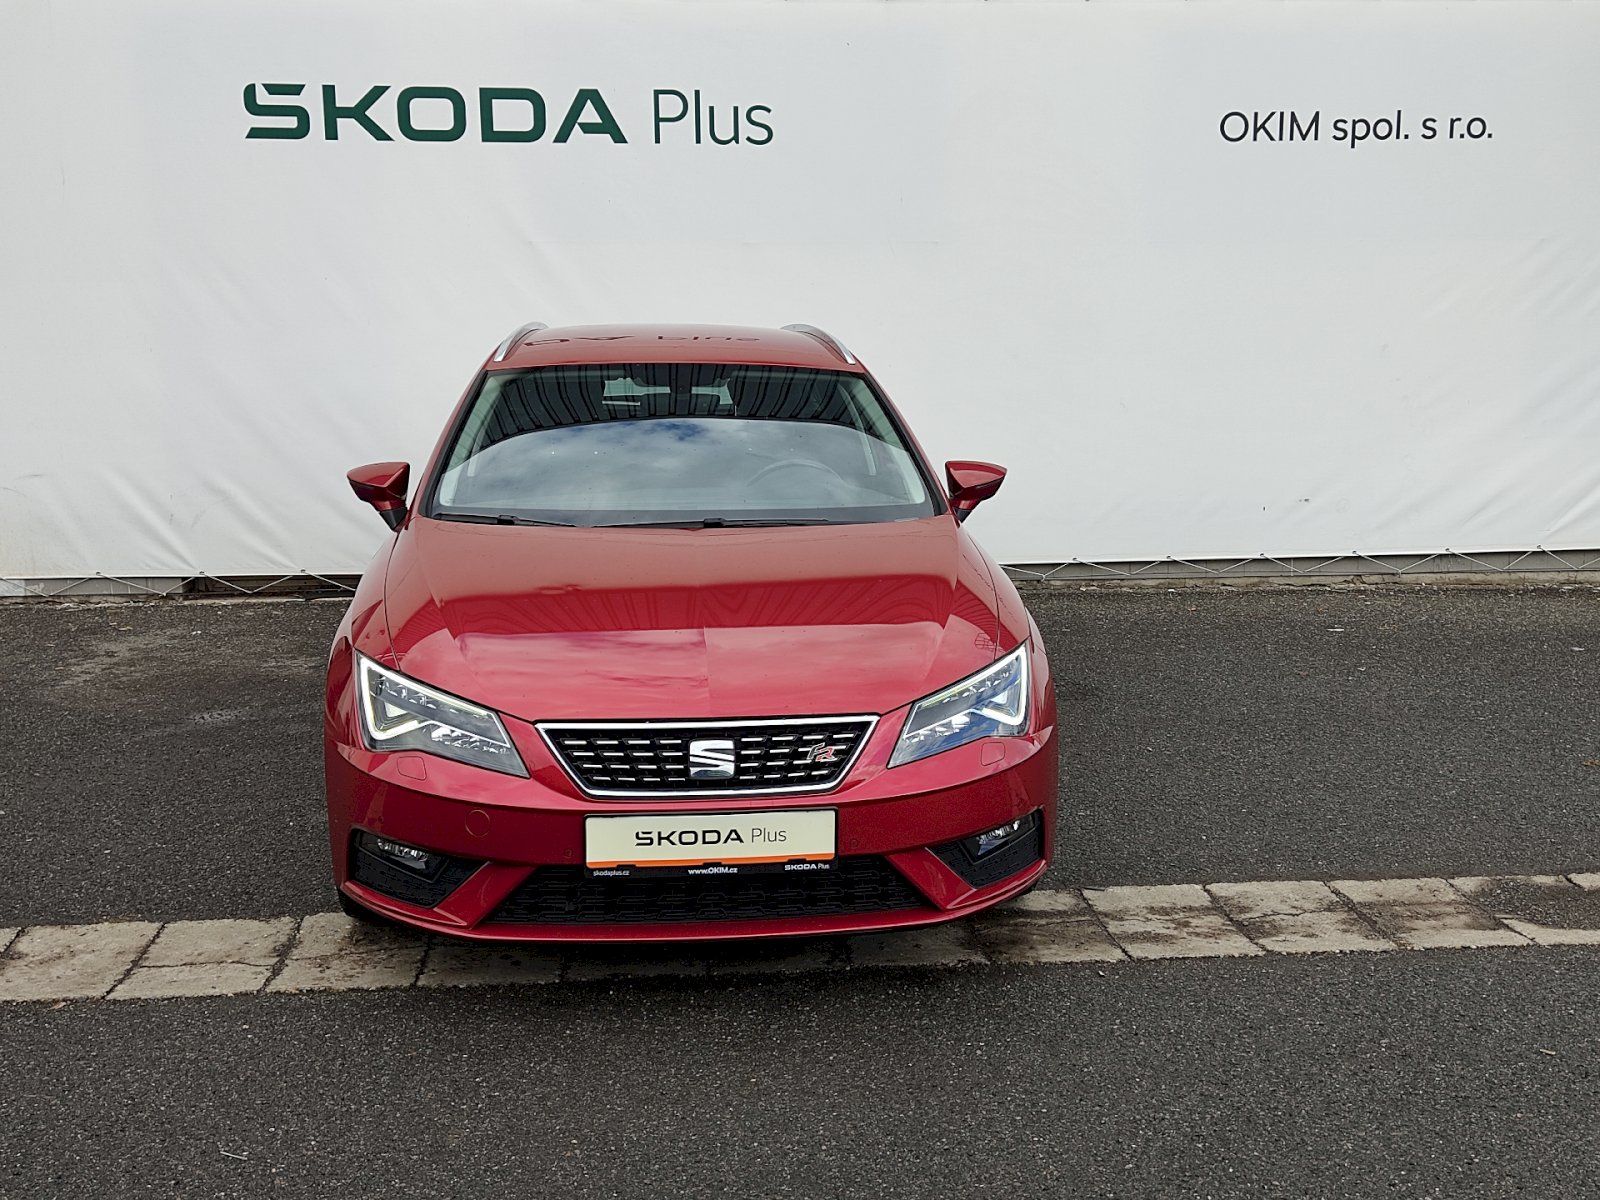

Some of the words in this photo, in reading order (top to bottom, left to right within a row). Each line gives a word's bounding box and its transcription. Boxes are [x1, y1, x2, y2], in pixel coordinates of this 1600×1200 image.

[653, 89, 774, 146] Plus
[1219, 110, 1320, 143] OKIM
[1332, 109, 1410, 149] spol.
[1420, 117, 1438, 140] s
[1449, 116, 1493, 139] r.o.
[751, 827, 787, 843] Plus
[688, 866, 738, 876] www.OKIM.cz
